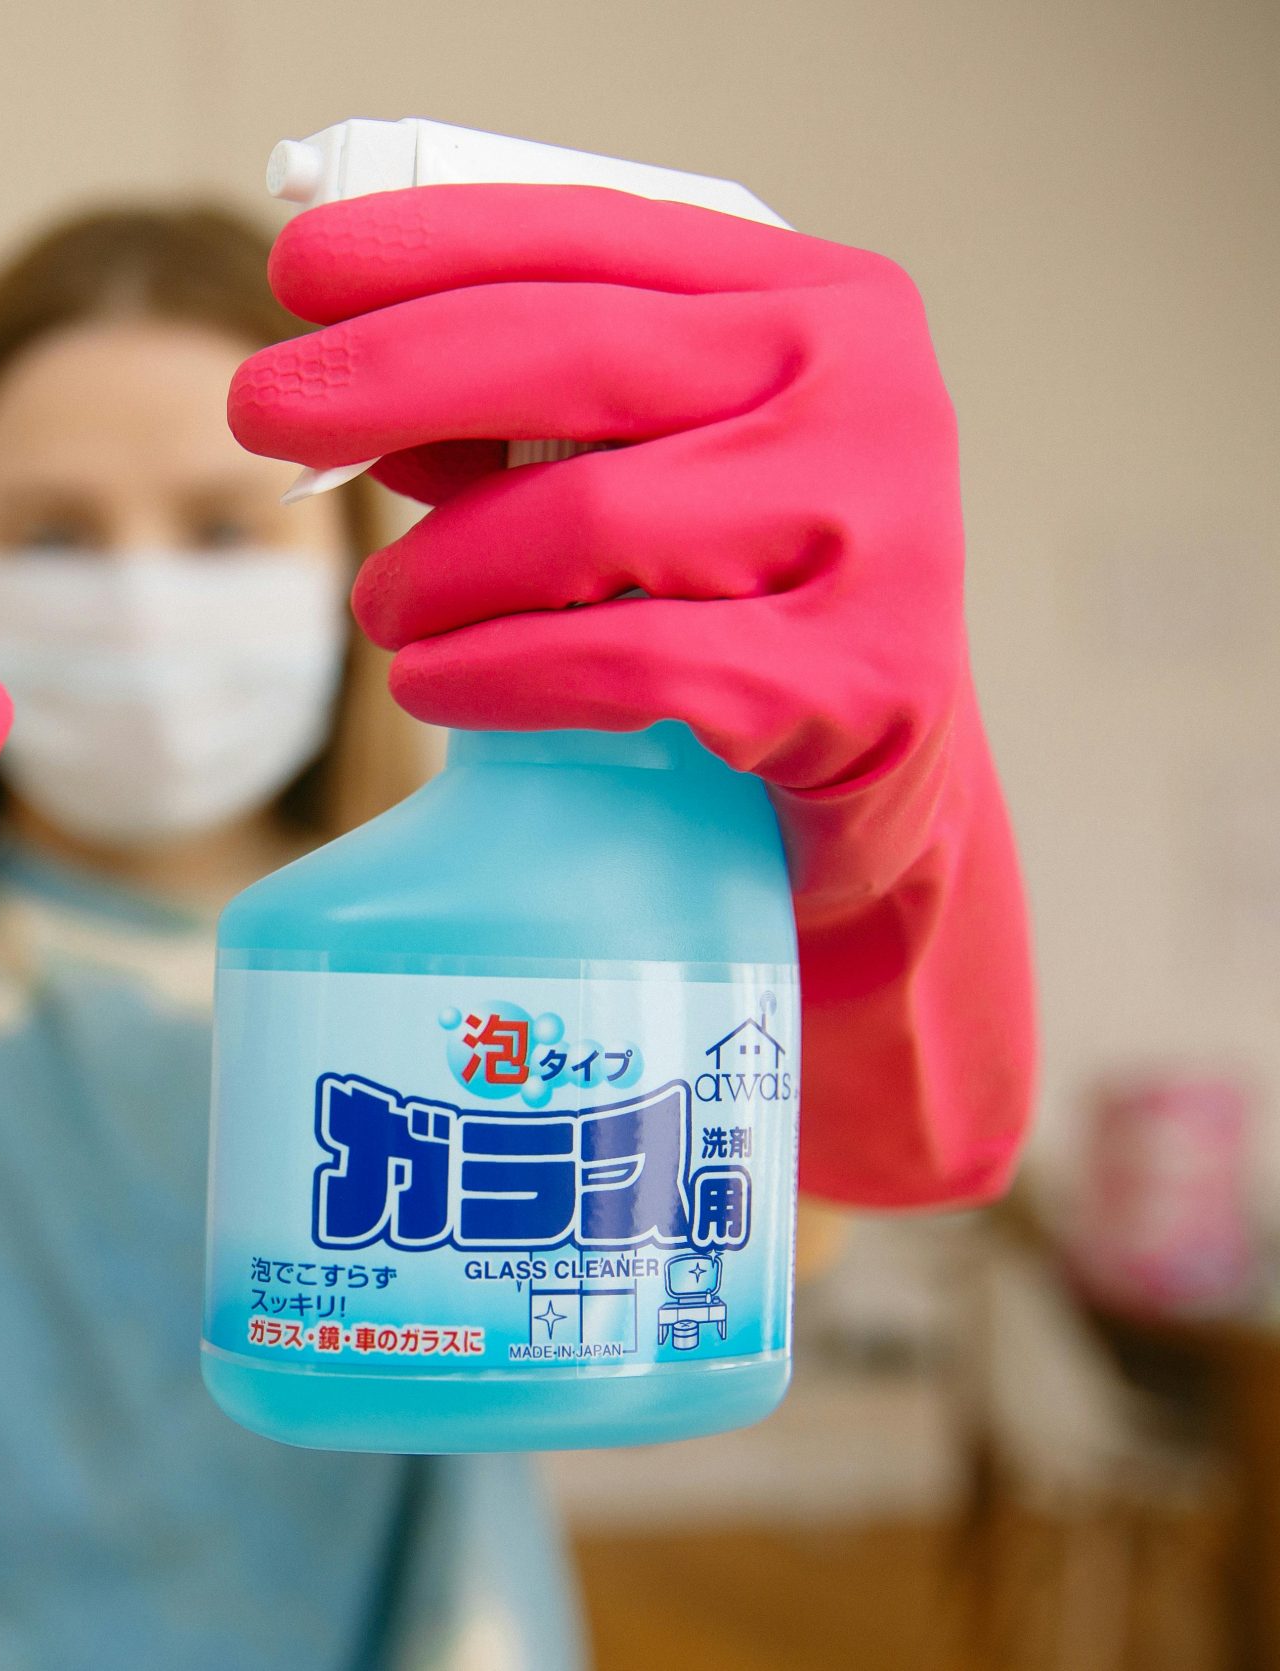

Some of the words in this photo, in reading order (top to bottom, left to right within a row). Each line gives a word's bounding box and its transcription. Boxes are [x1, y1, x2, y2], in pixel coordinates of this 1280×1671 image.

[701, 1126, 753, 1159] 洗剤
[250, 1256, 398, 1290] 泡でこすらず
[464, 1260, 548, 1280] GLASS
[554, 1257, 660, 1279] CLEANER
[575, 1343, 622, 1358] JAPAN
